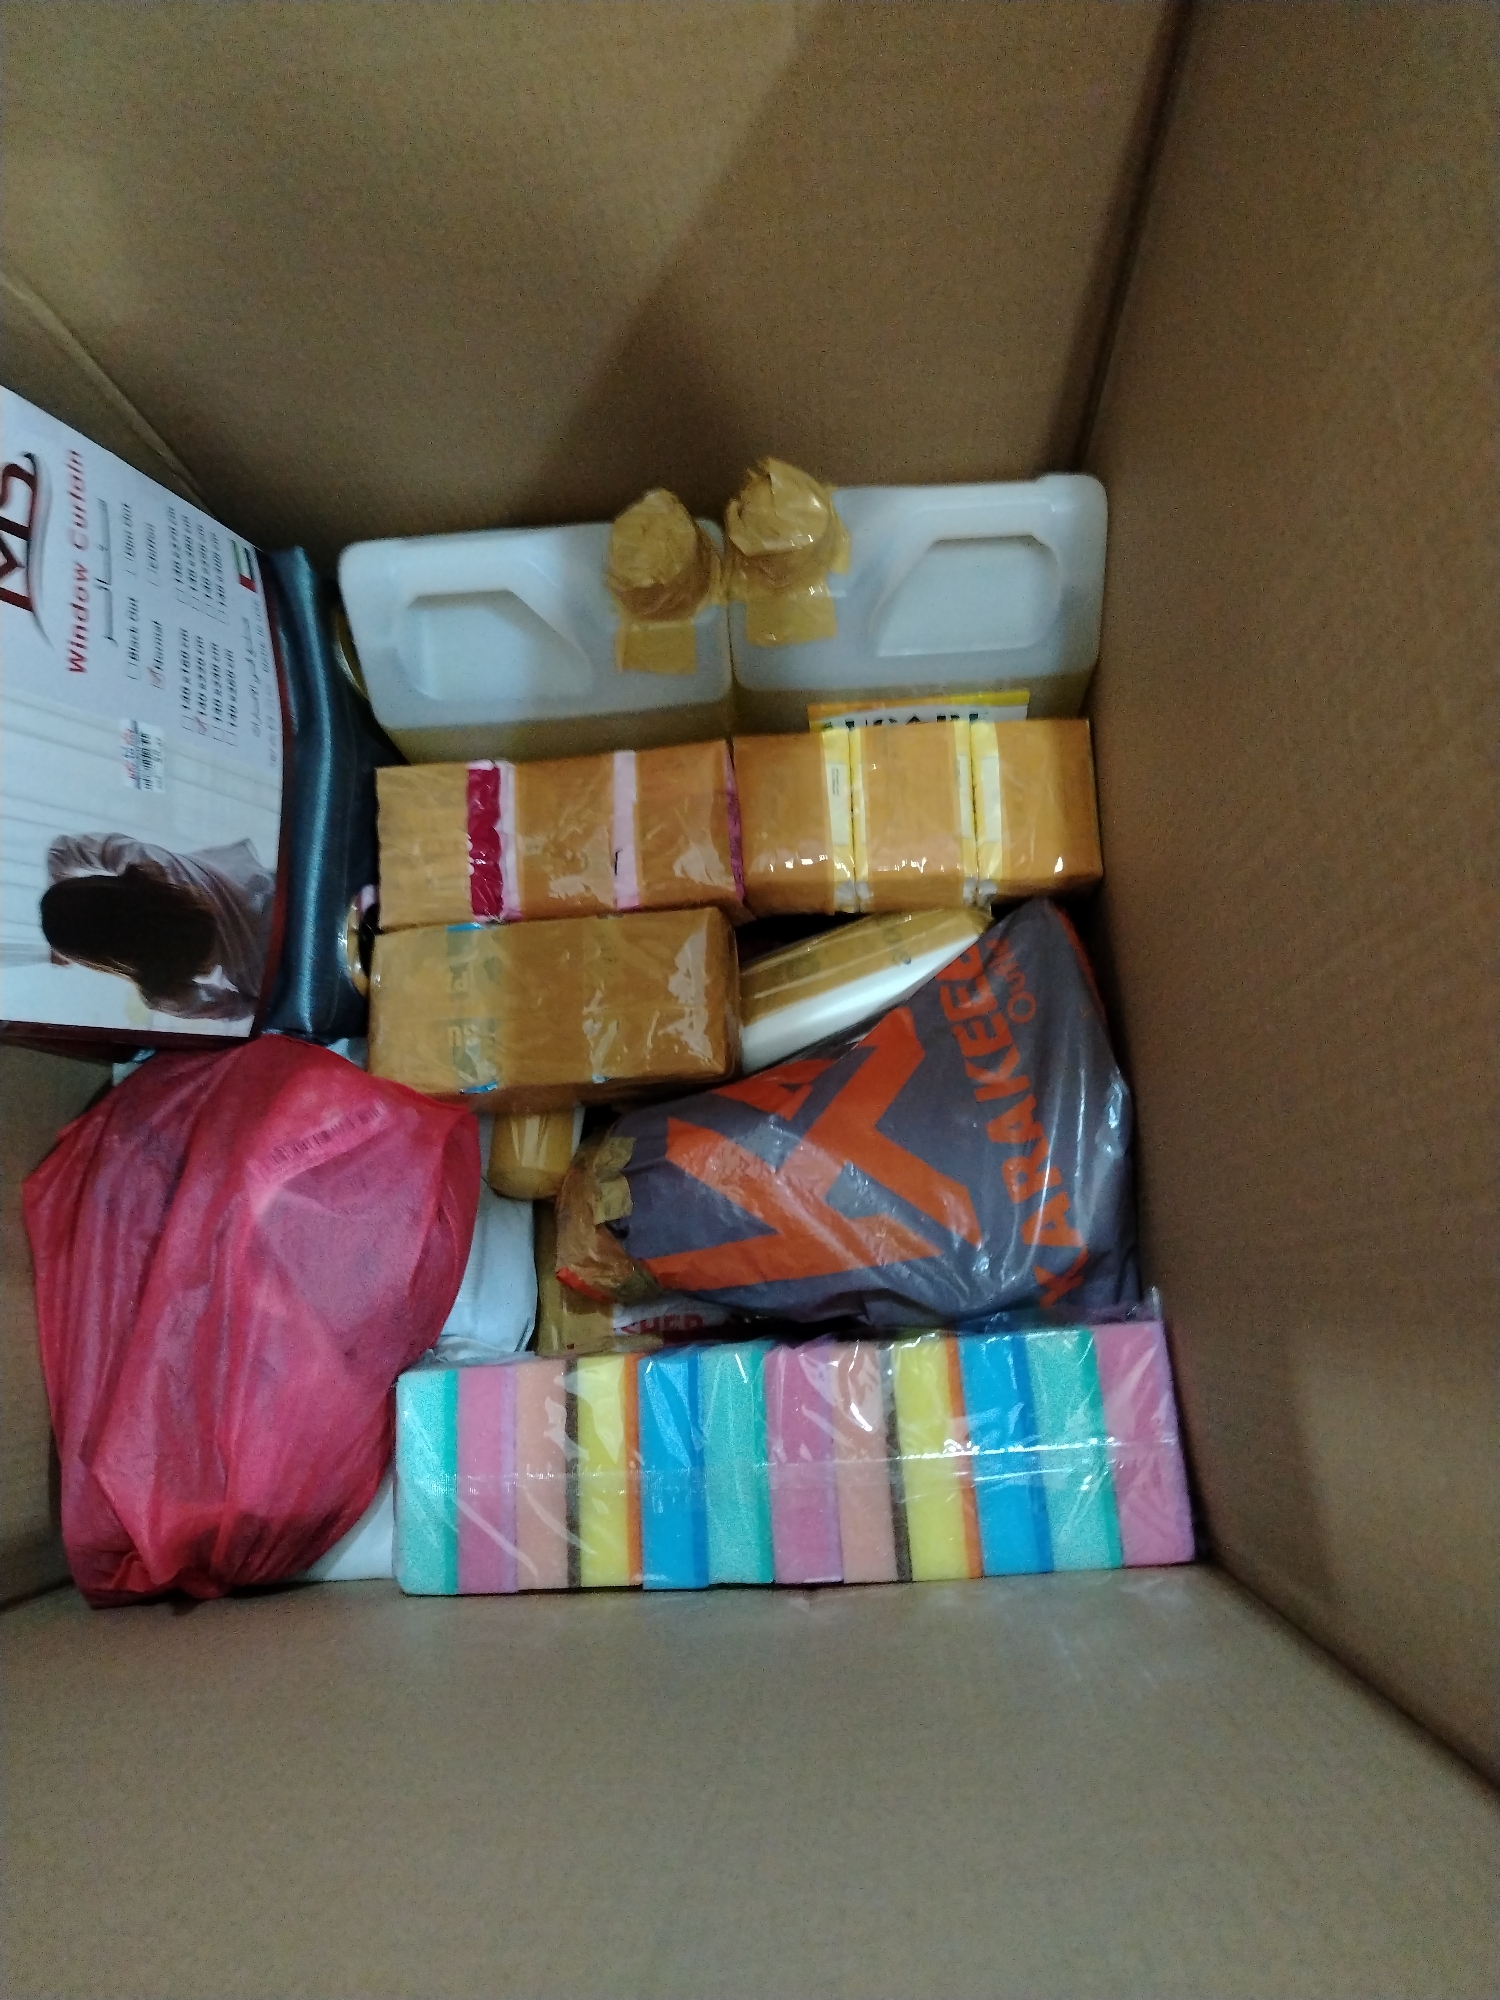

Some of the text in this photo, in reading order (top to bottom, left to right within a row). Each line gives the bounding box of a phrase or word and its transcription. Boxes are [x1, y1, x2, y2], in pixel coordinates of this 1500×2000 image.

[65, 449, 88, 673] Window Curtain
[127, 597, 140, 661] Black Out
[151, 620, 163, 671] Normal
